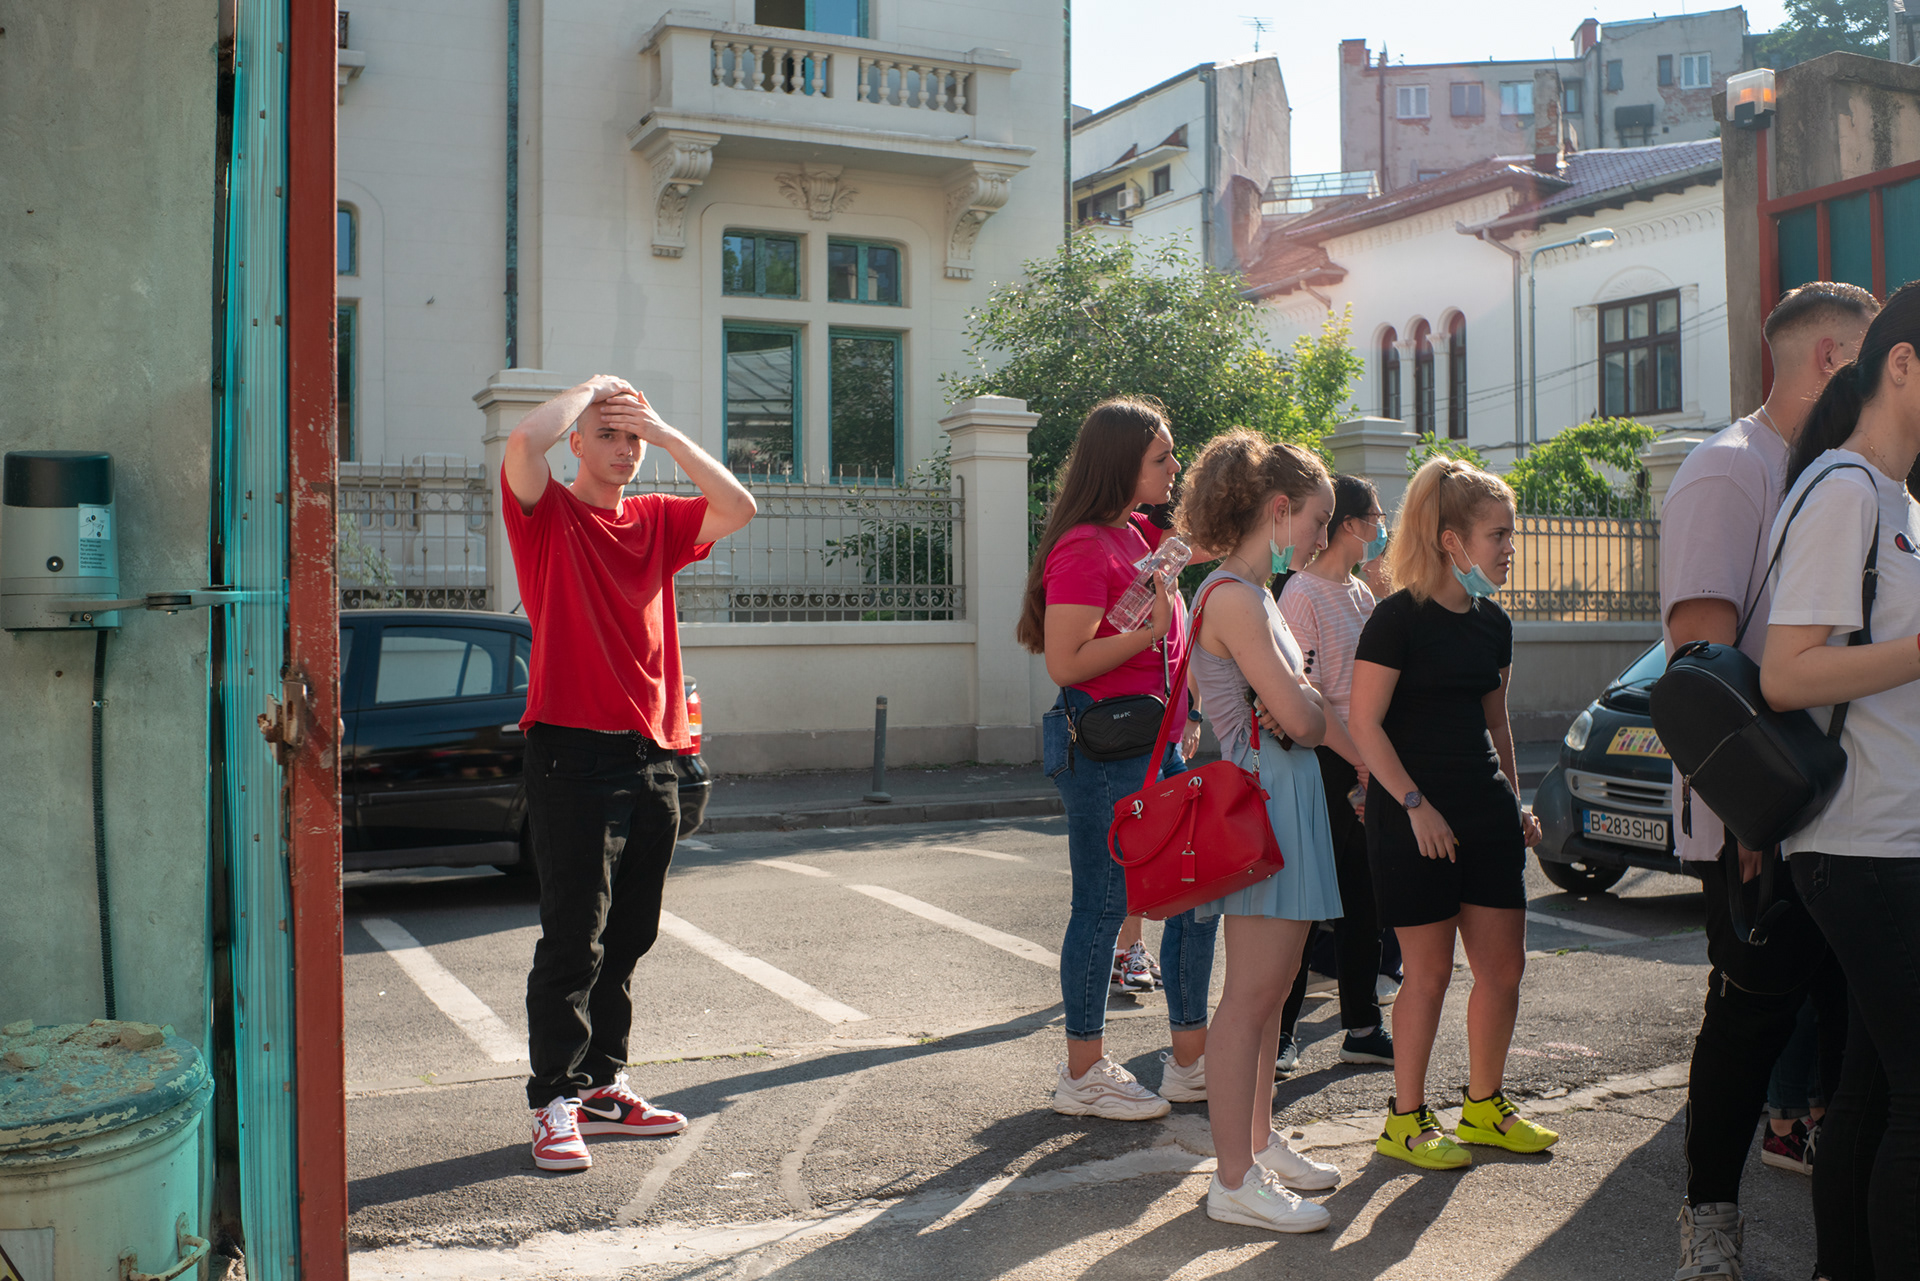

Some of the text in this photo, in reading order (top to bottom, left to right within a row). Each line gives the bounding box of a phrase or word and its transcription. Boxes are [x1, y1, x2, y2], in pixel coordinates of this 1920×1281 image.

[1590, 813, 1664, 841] B 283 SHO
